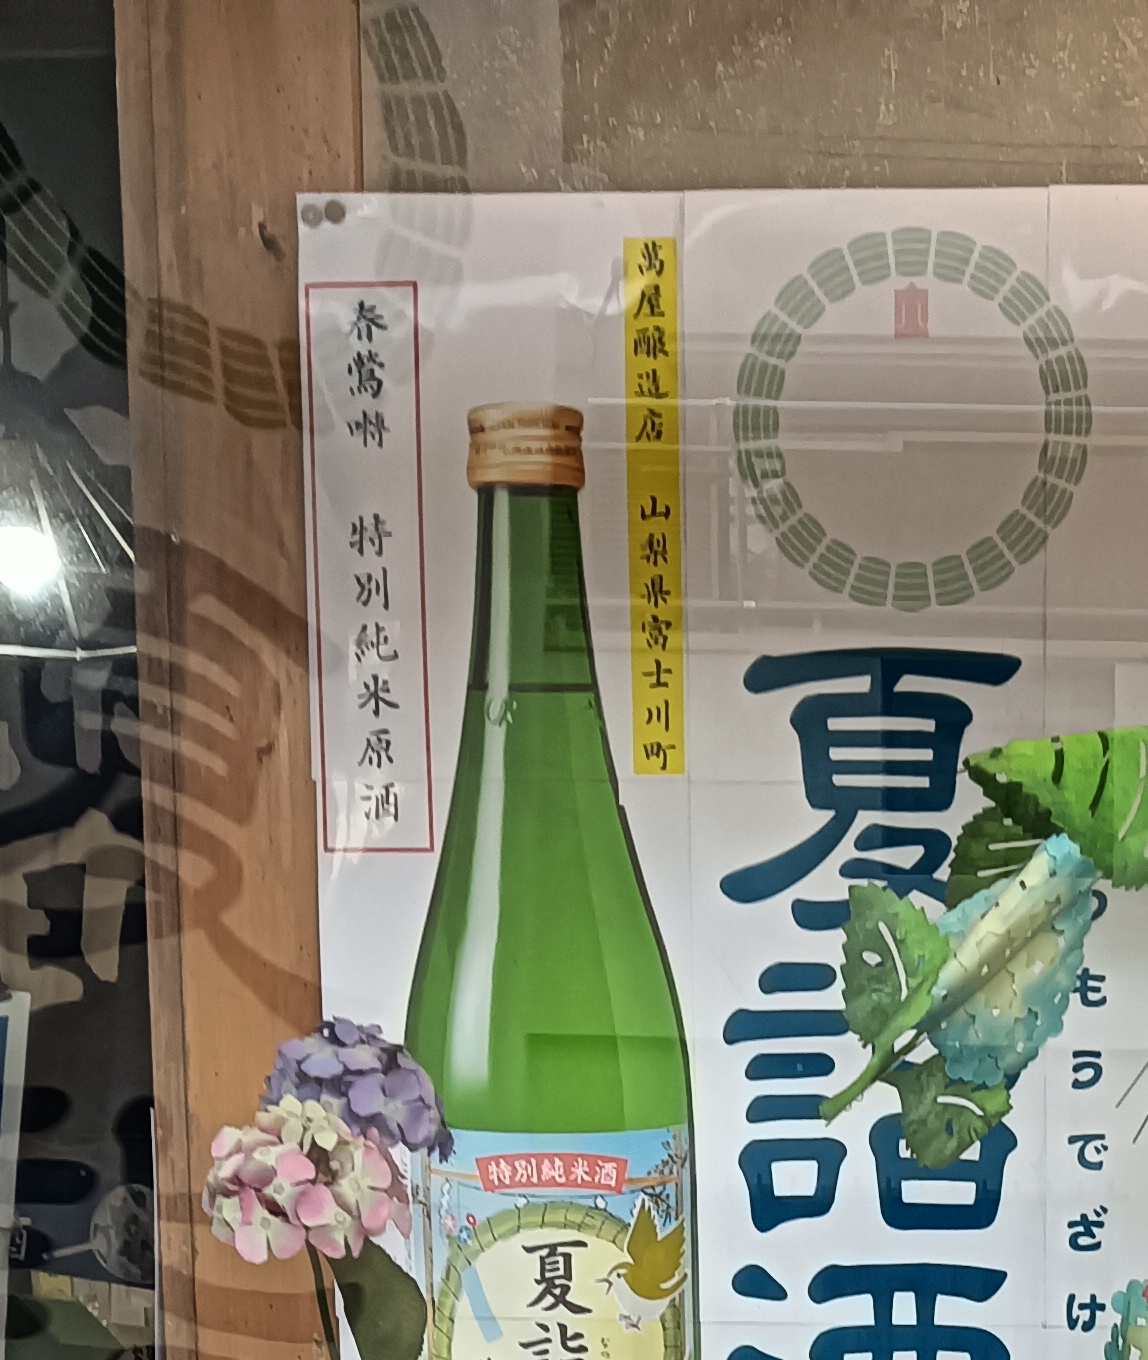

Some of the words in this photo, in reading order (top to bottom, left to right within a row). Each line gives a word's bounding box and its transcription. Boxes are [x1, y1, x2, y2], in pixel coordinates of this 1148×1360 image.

[350, 513, 402, 824] 特別純米原酒
[638, 495, 678, 769] 山梨県富士川町
[488, 1157, 619, 1190] 特別純米酒
